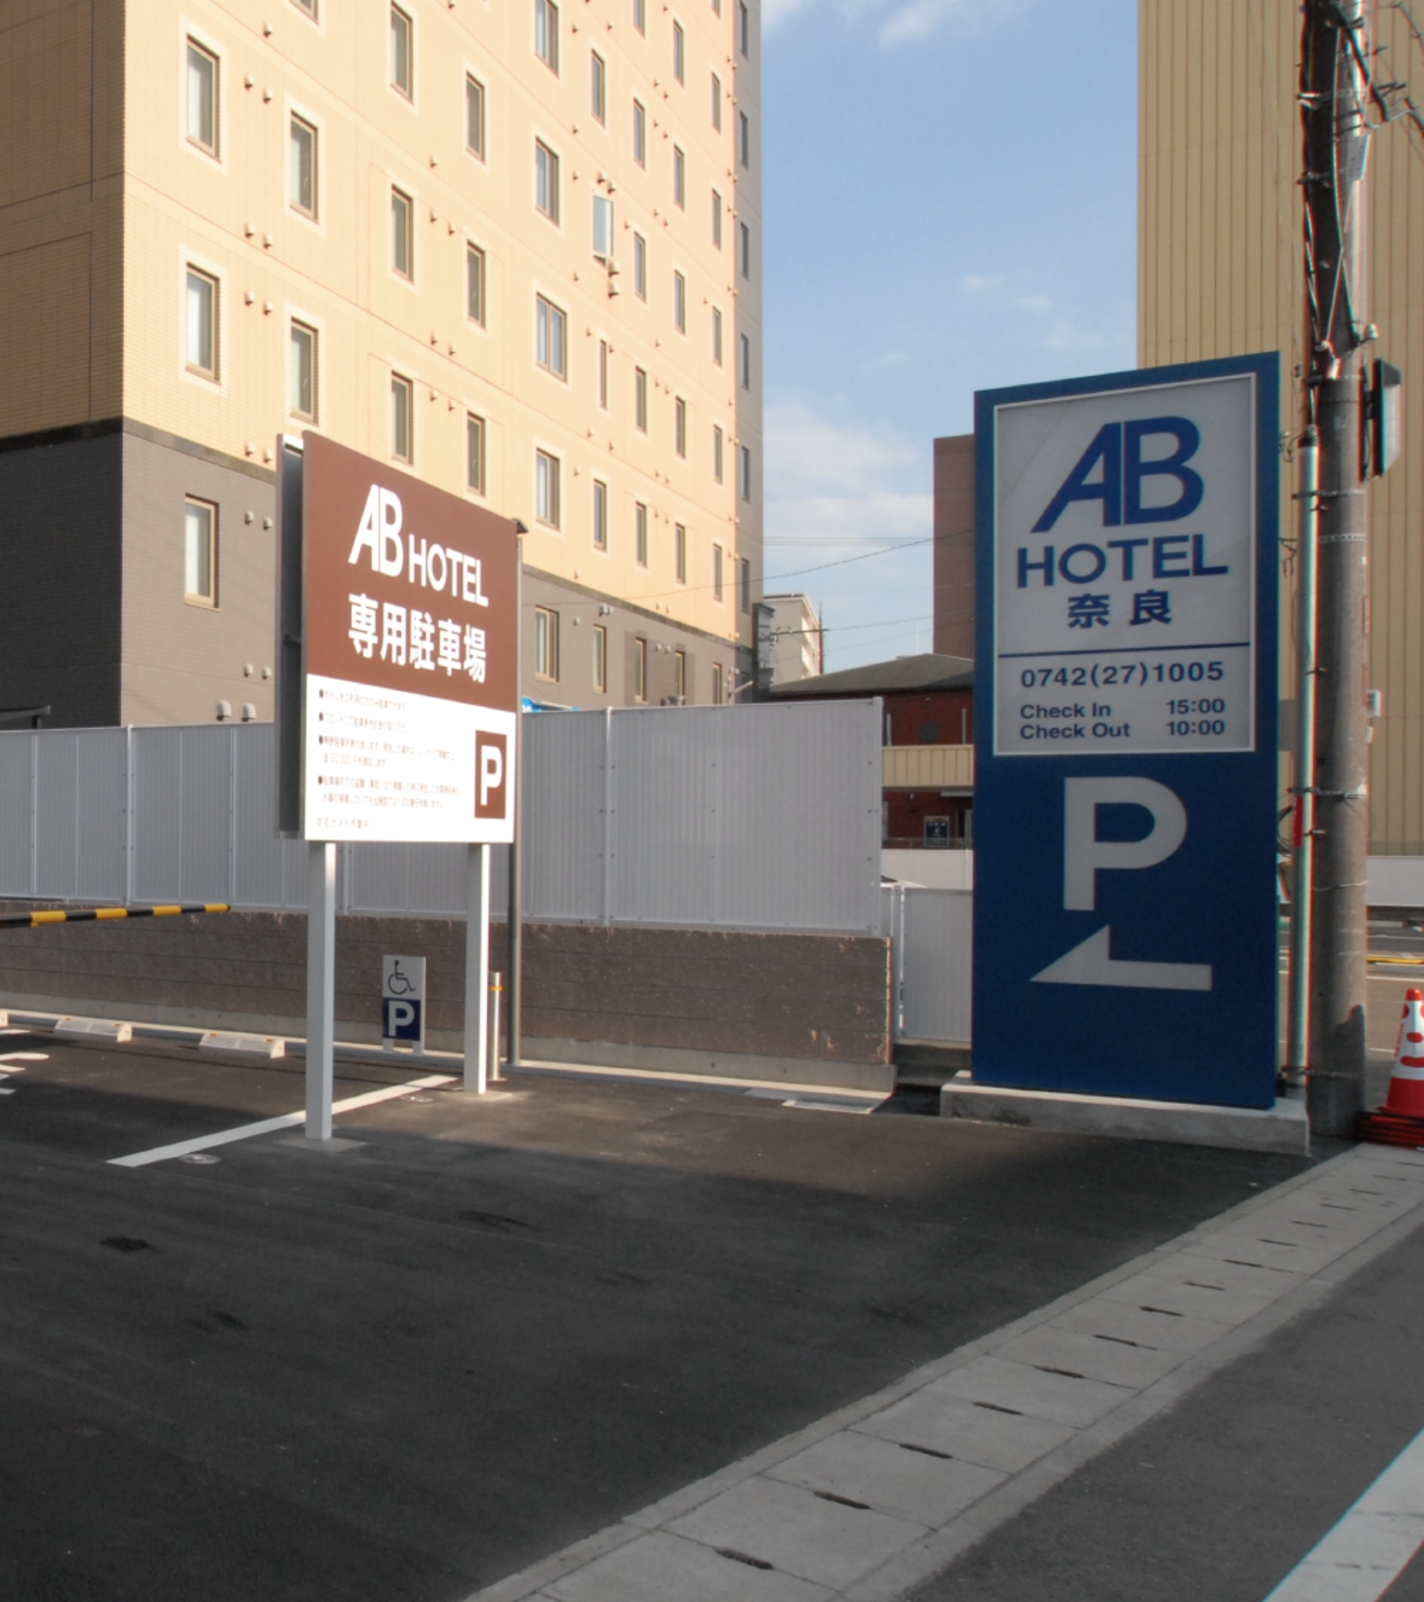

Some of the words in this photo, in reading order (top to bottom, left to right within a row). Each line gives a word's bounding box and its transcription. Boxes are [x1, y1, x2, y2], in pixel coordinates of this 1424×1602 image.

[1030, 415, 1205, 534] AB
[348, 483, 404, 577] AB
[408, 533, 489, 608] HOTEL
[1016, 534, 1230, 588] HOTEL
[1067, 589, 1173, 629] 奈良
[347, 592, 487, 685] 専用駐車場
[1020, 660, 1225, 689] 0742(27)1005
[1019, 702, 1086, 720] Check
[1091, 702, 1113, 718] In
[1166, 697, 1227, 716] 15:00
[1019, 723, 1086, 740] Check
[1091, 721, 1131, 738] Out
[1166, 718, 1227, 737] 10:00
[480, 744, 503, 806] P
[1063, 776, 1188, 911] P
[387, 1000, 415, 1037] P
